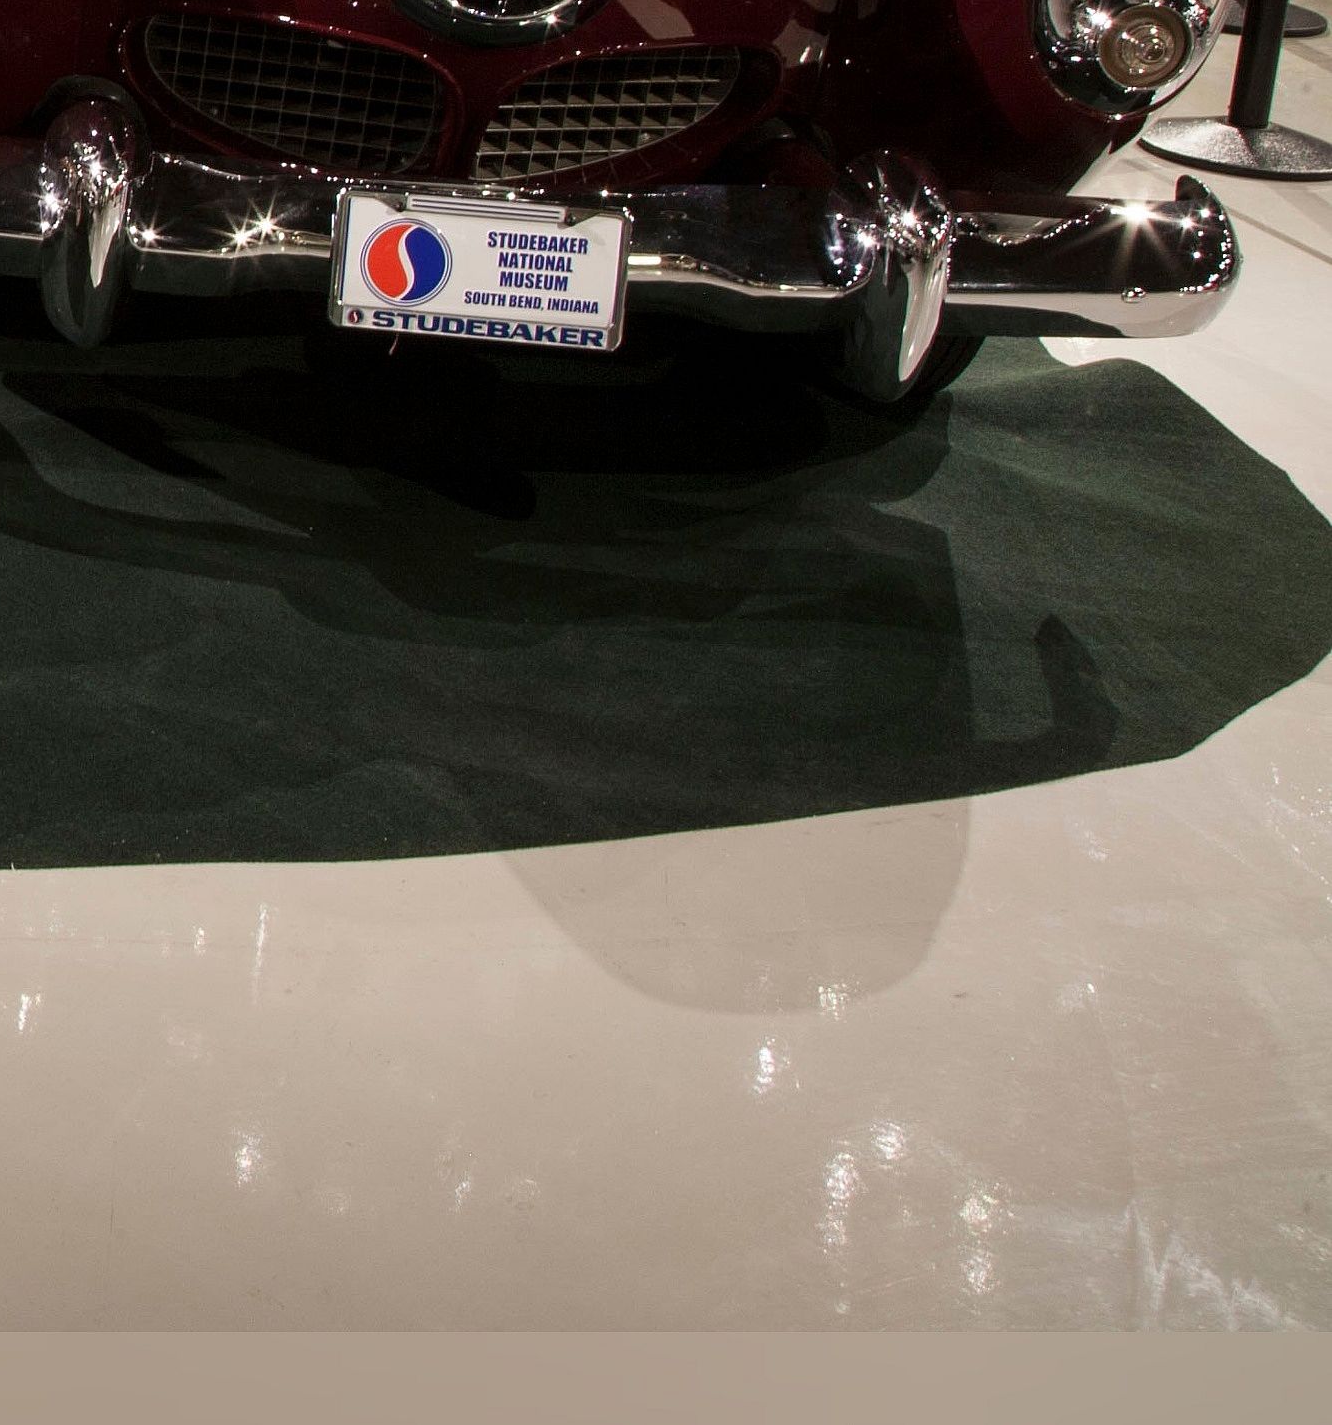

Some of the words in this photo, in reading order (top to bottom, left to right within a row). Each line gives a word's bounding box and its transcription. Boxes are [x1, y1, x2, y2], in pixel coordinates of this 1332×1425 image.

[487, 231, 589, 256] STUDEBAKER
[498, 251, 574, 273] NATIONAL
[499, 271, 569, 292] MUSEUM
[464, 291, 506, 307] SOUTH
[508, 294, 545, 312] BEND,
[547, 298, 600, 315] INDIANA
[372, 311, 604, 347] STUDEBAKER
